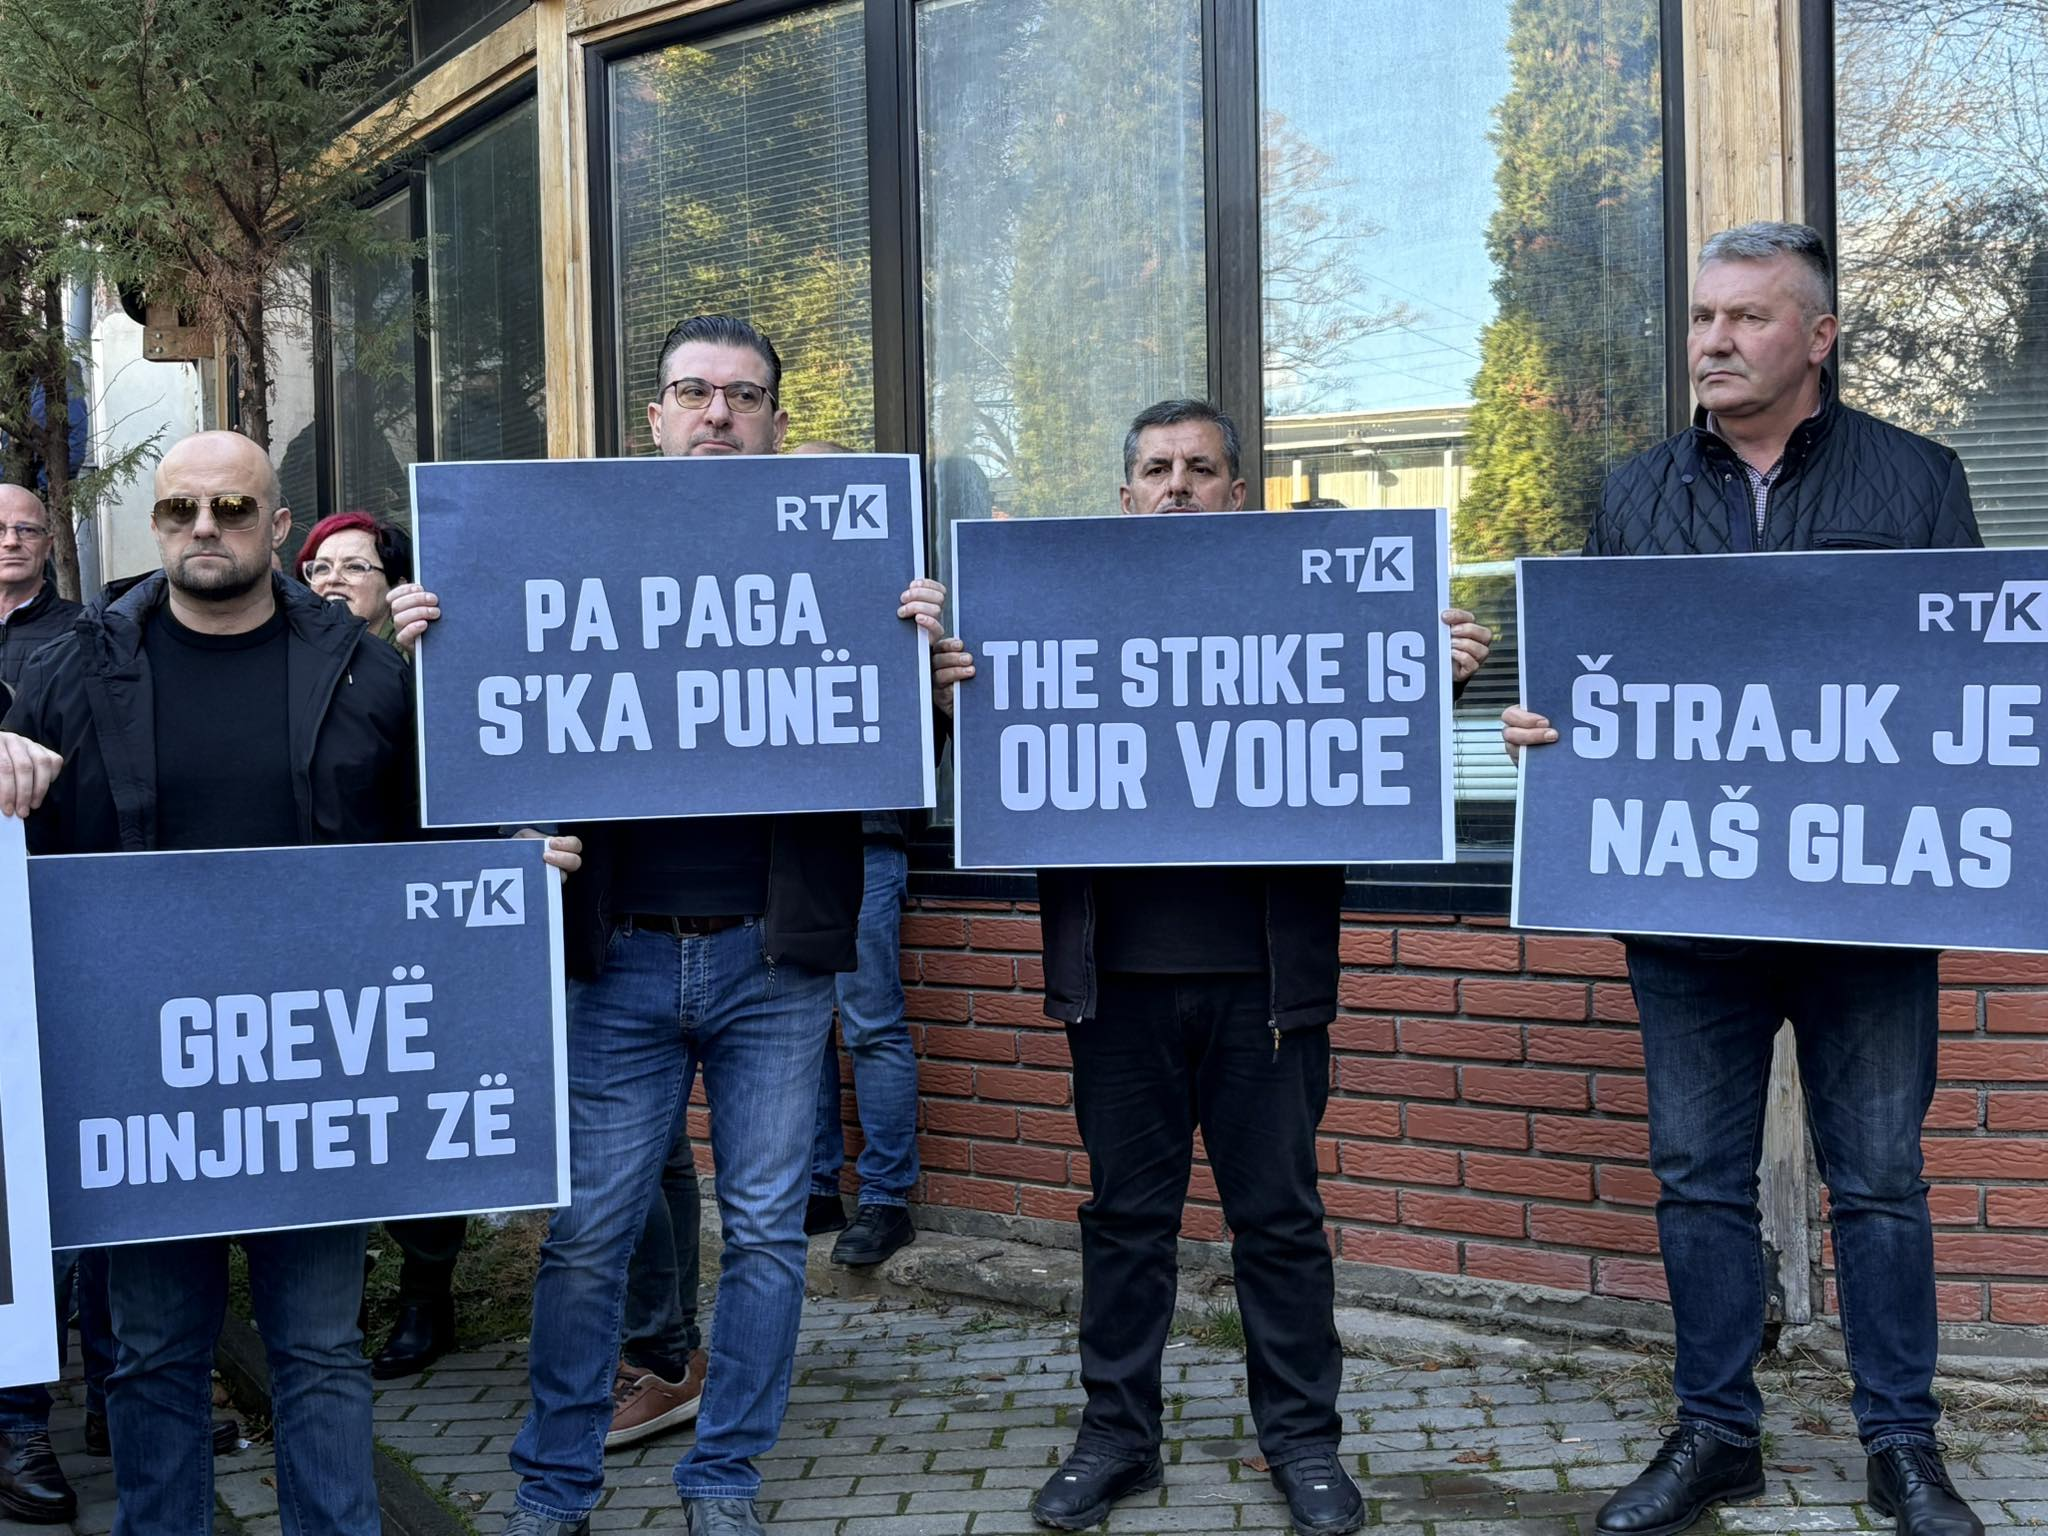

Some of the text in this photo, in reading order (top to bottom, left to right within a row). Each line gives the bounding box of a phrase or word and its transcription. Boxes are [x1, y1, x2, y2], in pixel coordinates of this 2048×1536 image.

[776, 491, 884, 533] RTK
[1300, 544, 1409, 586] RTK
[524, 572, 828, 653] PA PAGA
[1917, 588, 2045, 634] RTK
[676, 648, 881, 750] PUNË!
[982, 630, 1426, 711] THE STRIKE IS
[1571, 654, 2042, 767] ŠTRAJK JE
[999, 716, 1411, 812] OUR VOICE
[1589, 784, 2013, 889] NAŠ GLAS
[404, 876, 519, 922] RTK
[159, 964, 436, 1088] GREVË
[79, 1072, 516, 1189] DINJITET ZË
